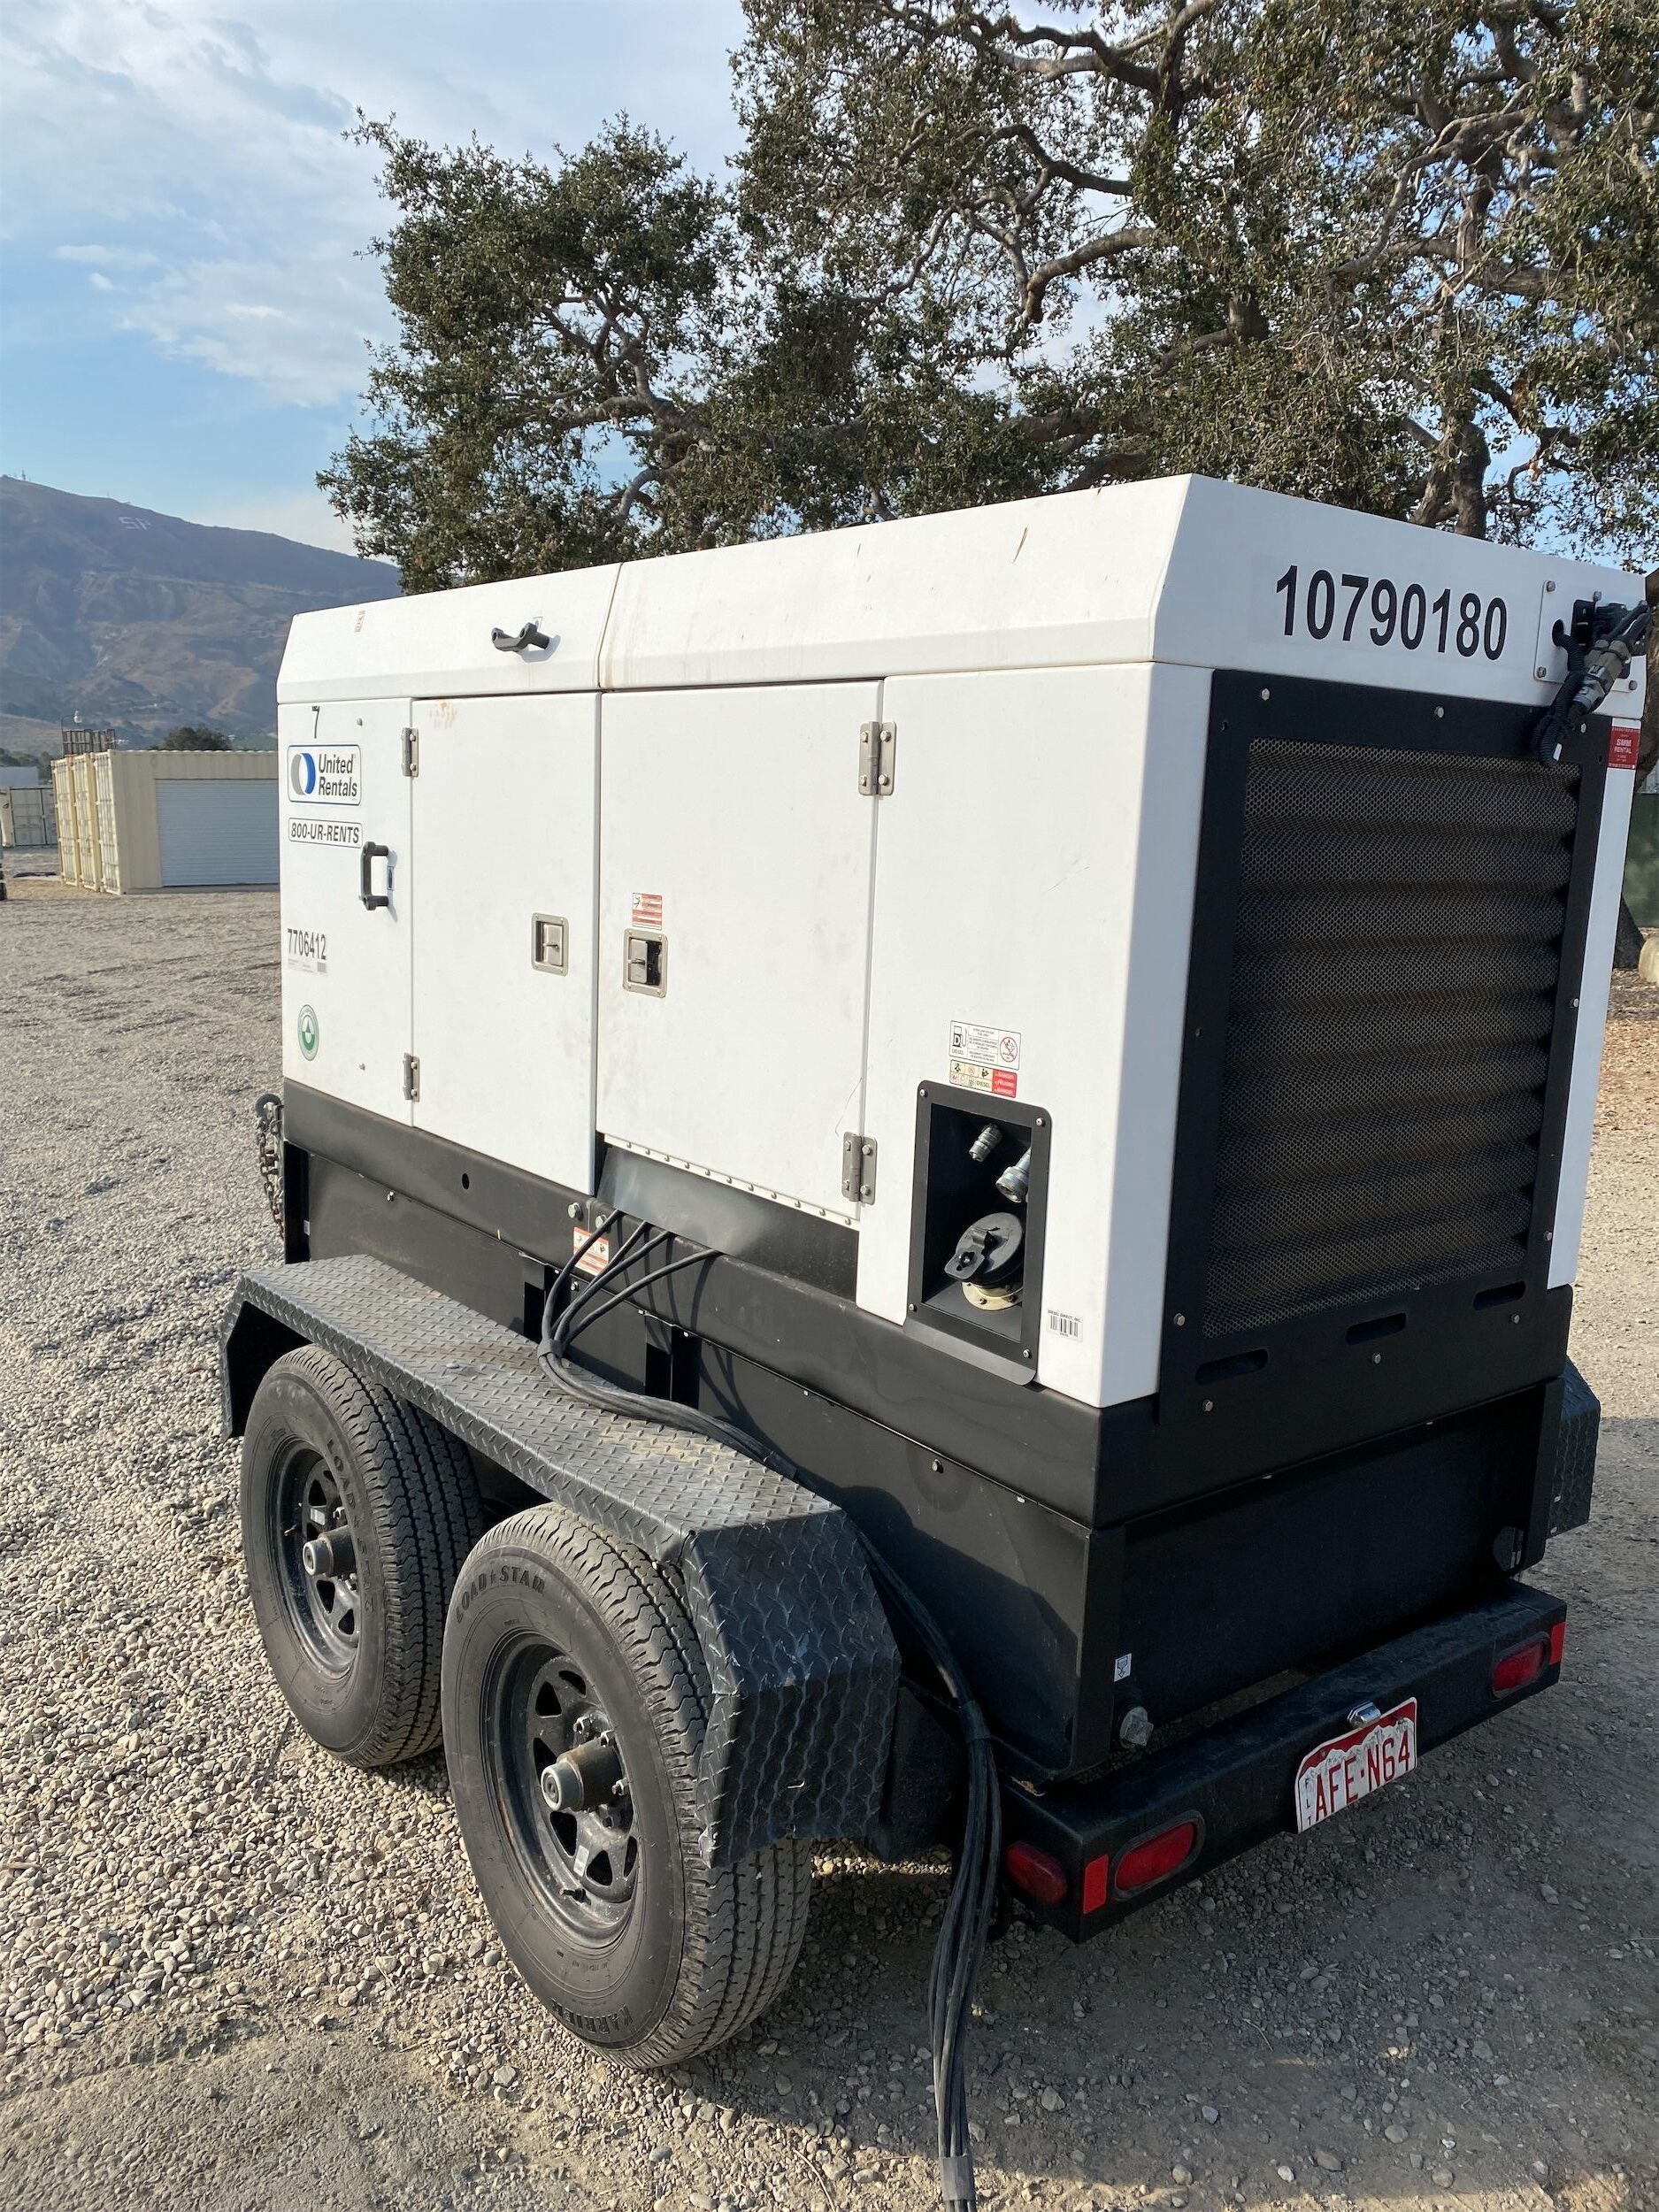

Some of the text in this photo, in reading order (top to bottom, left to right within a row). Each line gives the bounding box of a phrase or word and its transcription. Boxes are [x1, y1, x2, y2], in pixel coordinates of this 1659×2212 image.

[1276, 565, 1508, 661] 10790180
[311, 705, 320, 739] 7
[319, 753, 353, 774] United
[319, 776, 357, 797] Rentals
[291, 822, 359, 844] 800-UR-RENTS
[288, 928, 326, 960] 7706412
[326, 1439, 356, 1509] LOAD
[456, 1565, 547, 1624] LOAD STAR
